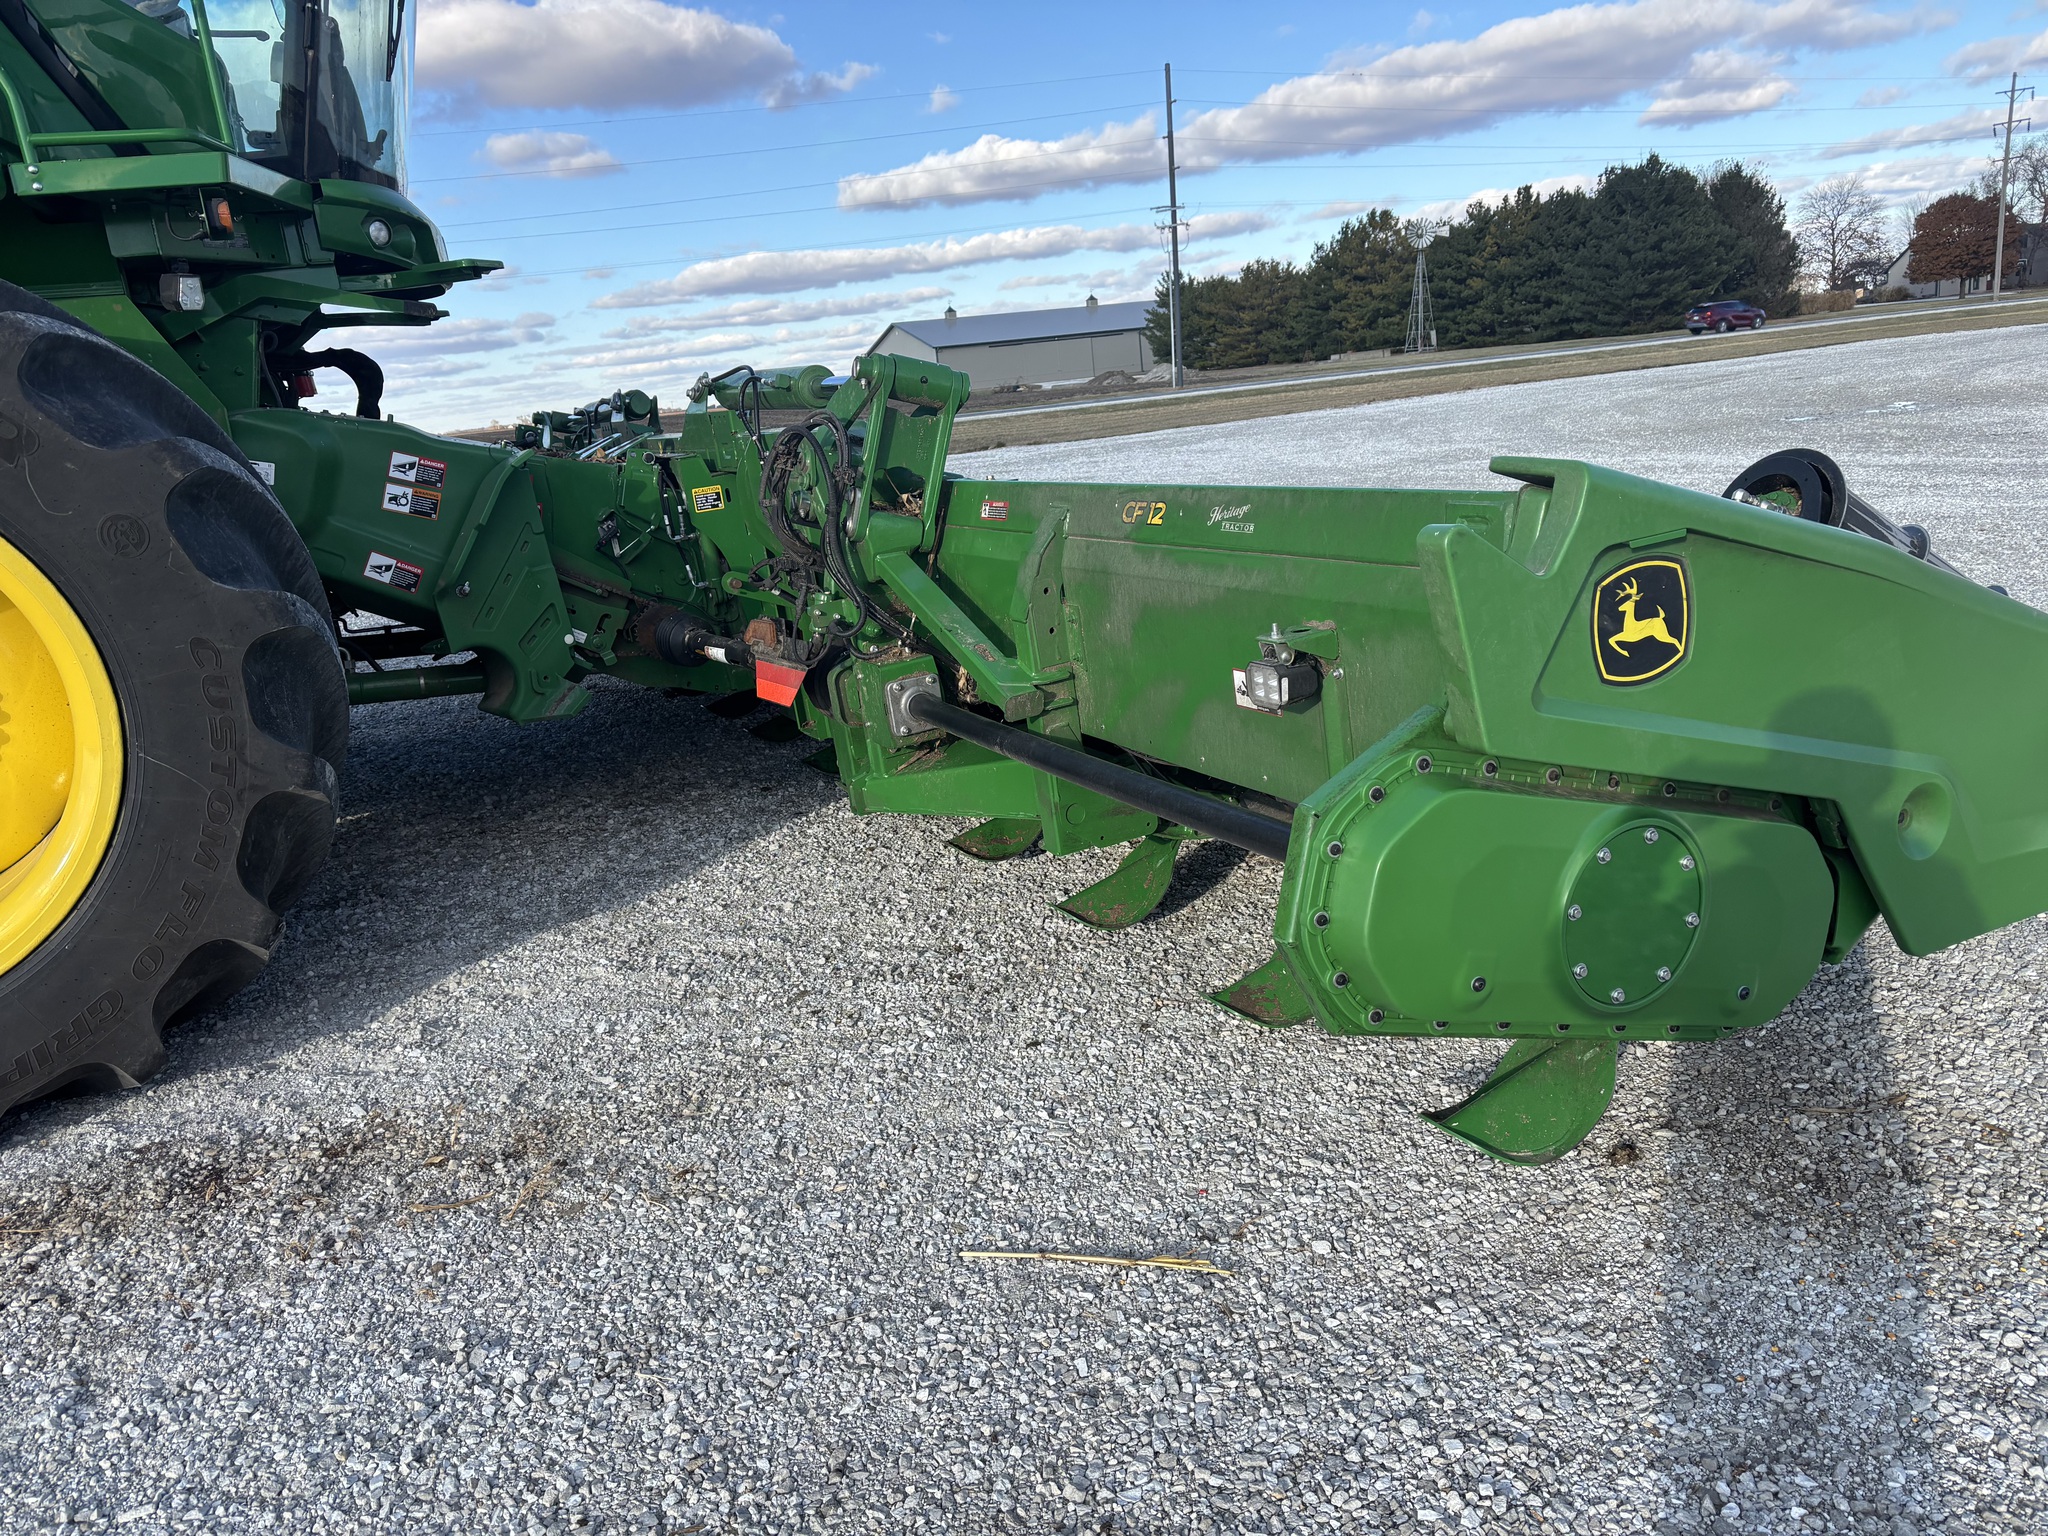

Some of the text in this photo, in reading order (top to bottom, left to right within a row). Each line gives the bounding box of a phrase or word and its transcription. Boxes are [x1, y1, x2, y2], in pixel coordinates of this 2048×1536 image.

[1207, 504, 1251, 526] Heritage
[1221, 522, 1255, 533] TRACTOR
[0, 636, 238, 1089] CUSTOM FLO GRIP
